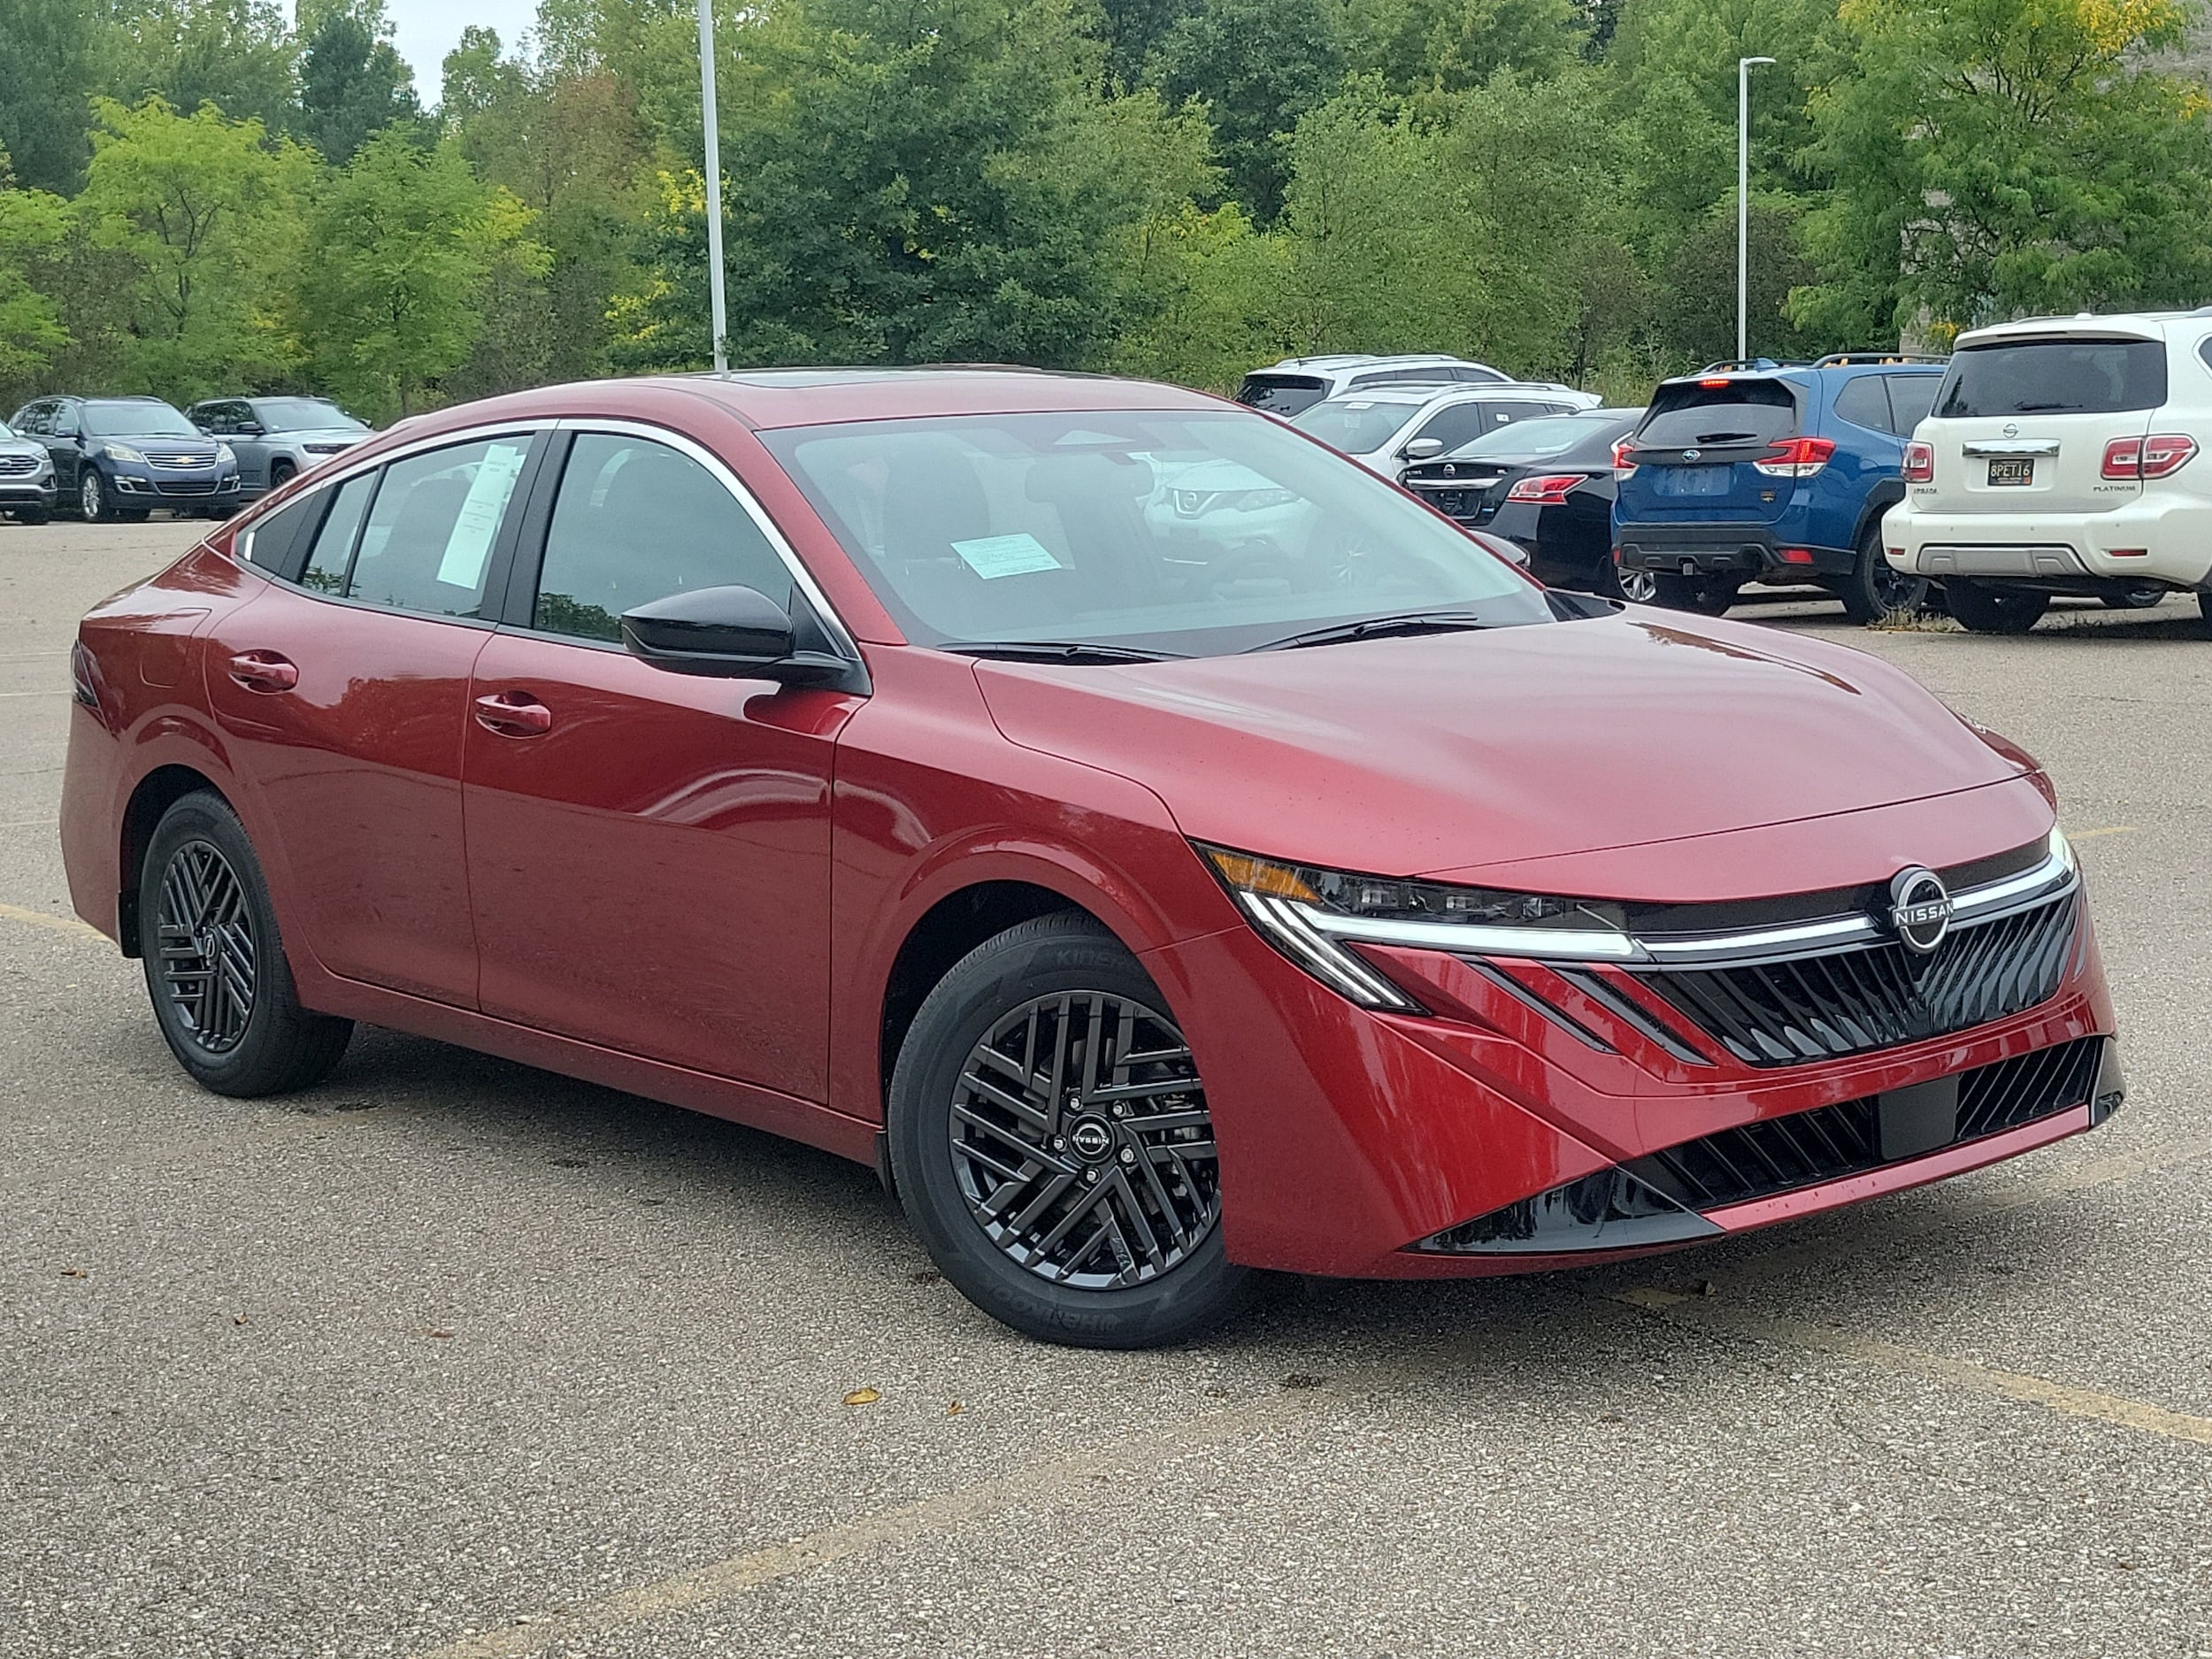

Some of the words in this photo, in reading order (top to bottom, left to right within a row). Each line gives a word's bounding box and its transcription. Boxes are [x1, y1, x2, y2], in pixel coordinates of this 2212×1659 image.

[1990, 465, 2031, 477] 8PET16
[1895, 902, 1953, 926] NISSAN
[1071, 1133, 1110, 1145] NISSAN
